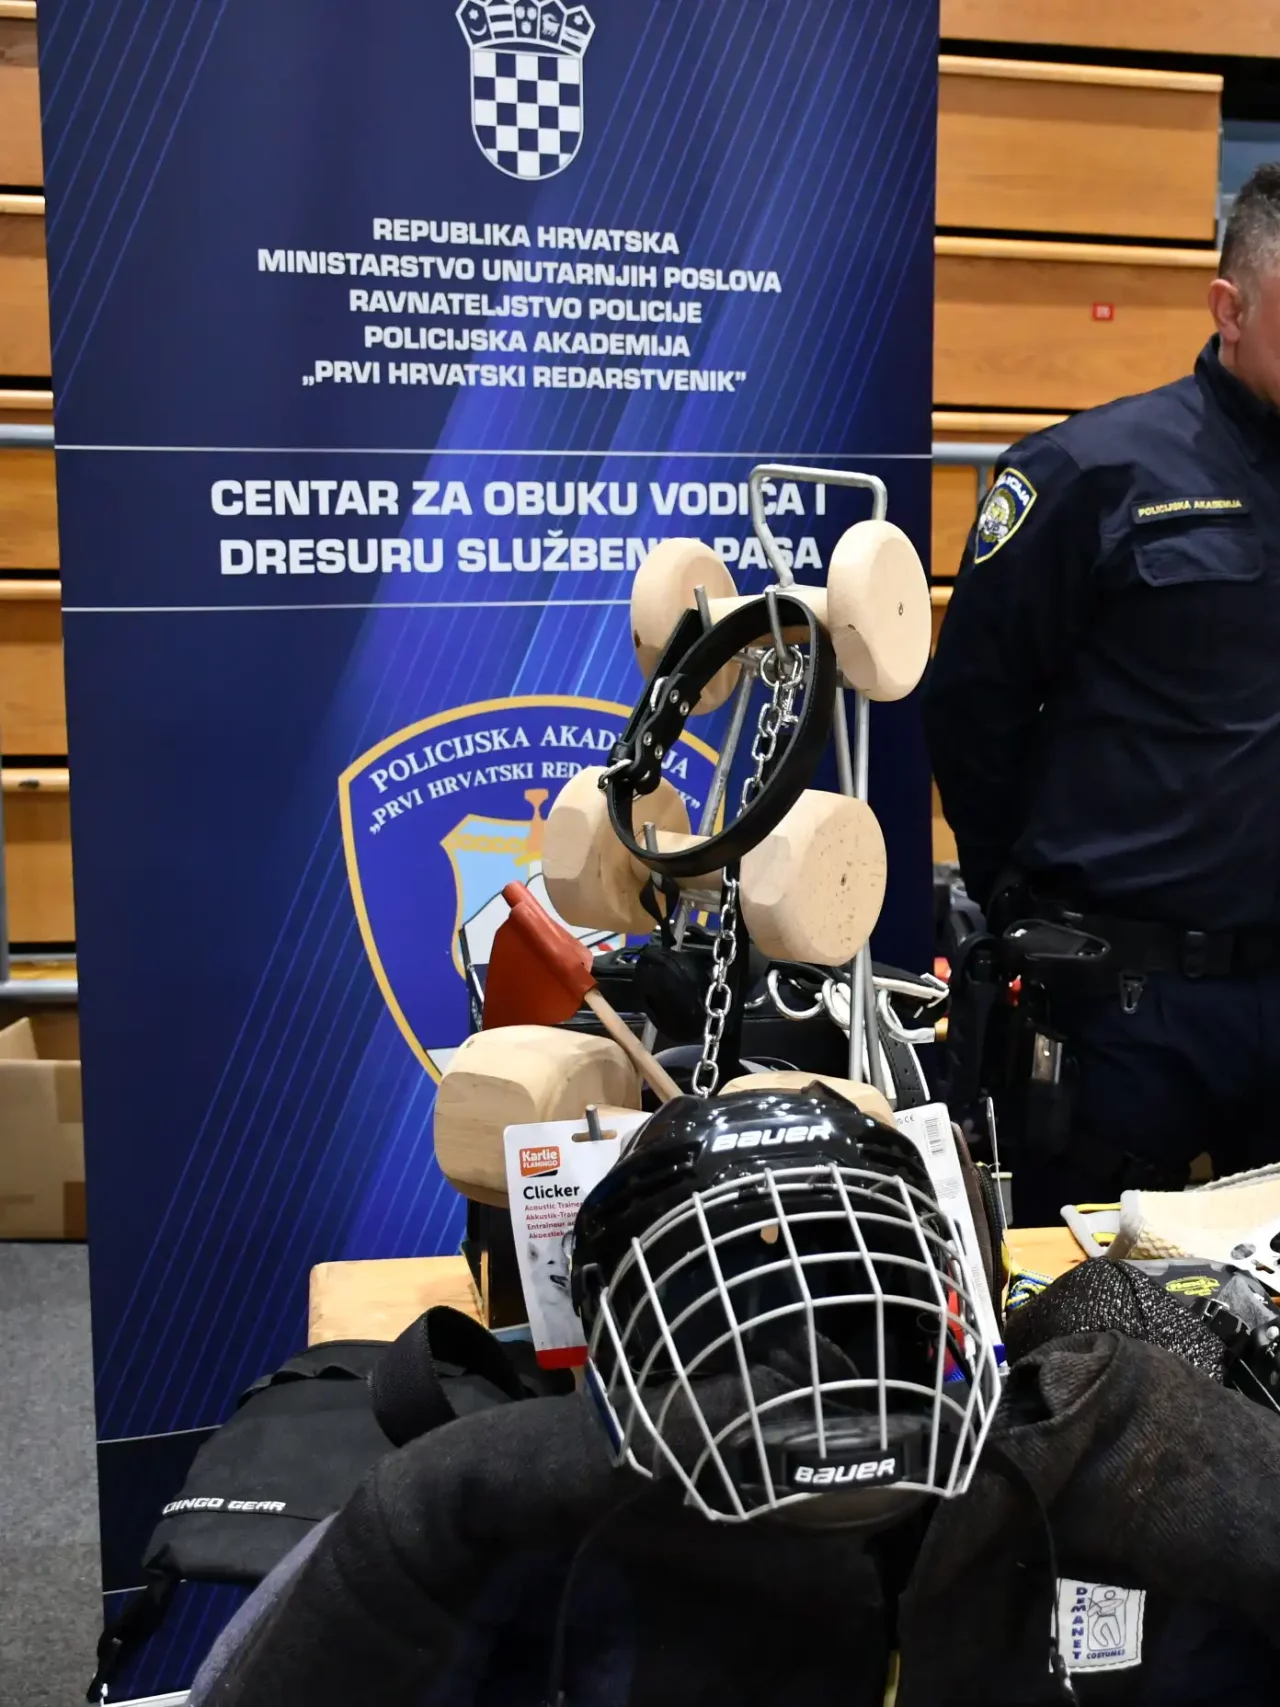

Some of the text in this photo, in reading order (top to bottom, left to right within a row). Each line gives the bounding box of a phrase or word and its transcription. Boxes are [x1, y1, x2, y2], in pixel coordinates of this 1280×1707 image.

[373, 217, 679, 254] REPUBLIKA HRVATSKA
[257, 248, 781, 293] MINISTARSTVO UNUTARNJIH POSLOVA
[349, 289, 702, 323] RAVNATELJSTVO POLICIJE
[364, 325, 690, 357] POLICIJSKA AKADEMIJA
[388, 362, 526, 388] HRVATSKI
[210, 480, 399, 516] CENTAR
[411, 480, 472, 516] ZA
[484, 481, 638, 516] OBUKU
[815, 483, 827, 516] I
[220, 537, 443, 575] DRESURU
[457, 529, 702, 574] SLUŽBEN
[369, 726, 530, 793] POLICIJSKA
[540, 725, 688, 780] AKADJA
[427, 762, 533, 799] HRVATSKI
[522, 1148, 558, 1162] Karlie
[523, 1184, 580, 1200] Clicker
[794, 1458, 896, 1485] BAUER
[162, 1498, 287, 1515] DINGO GEAR
